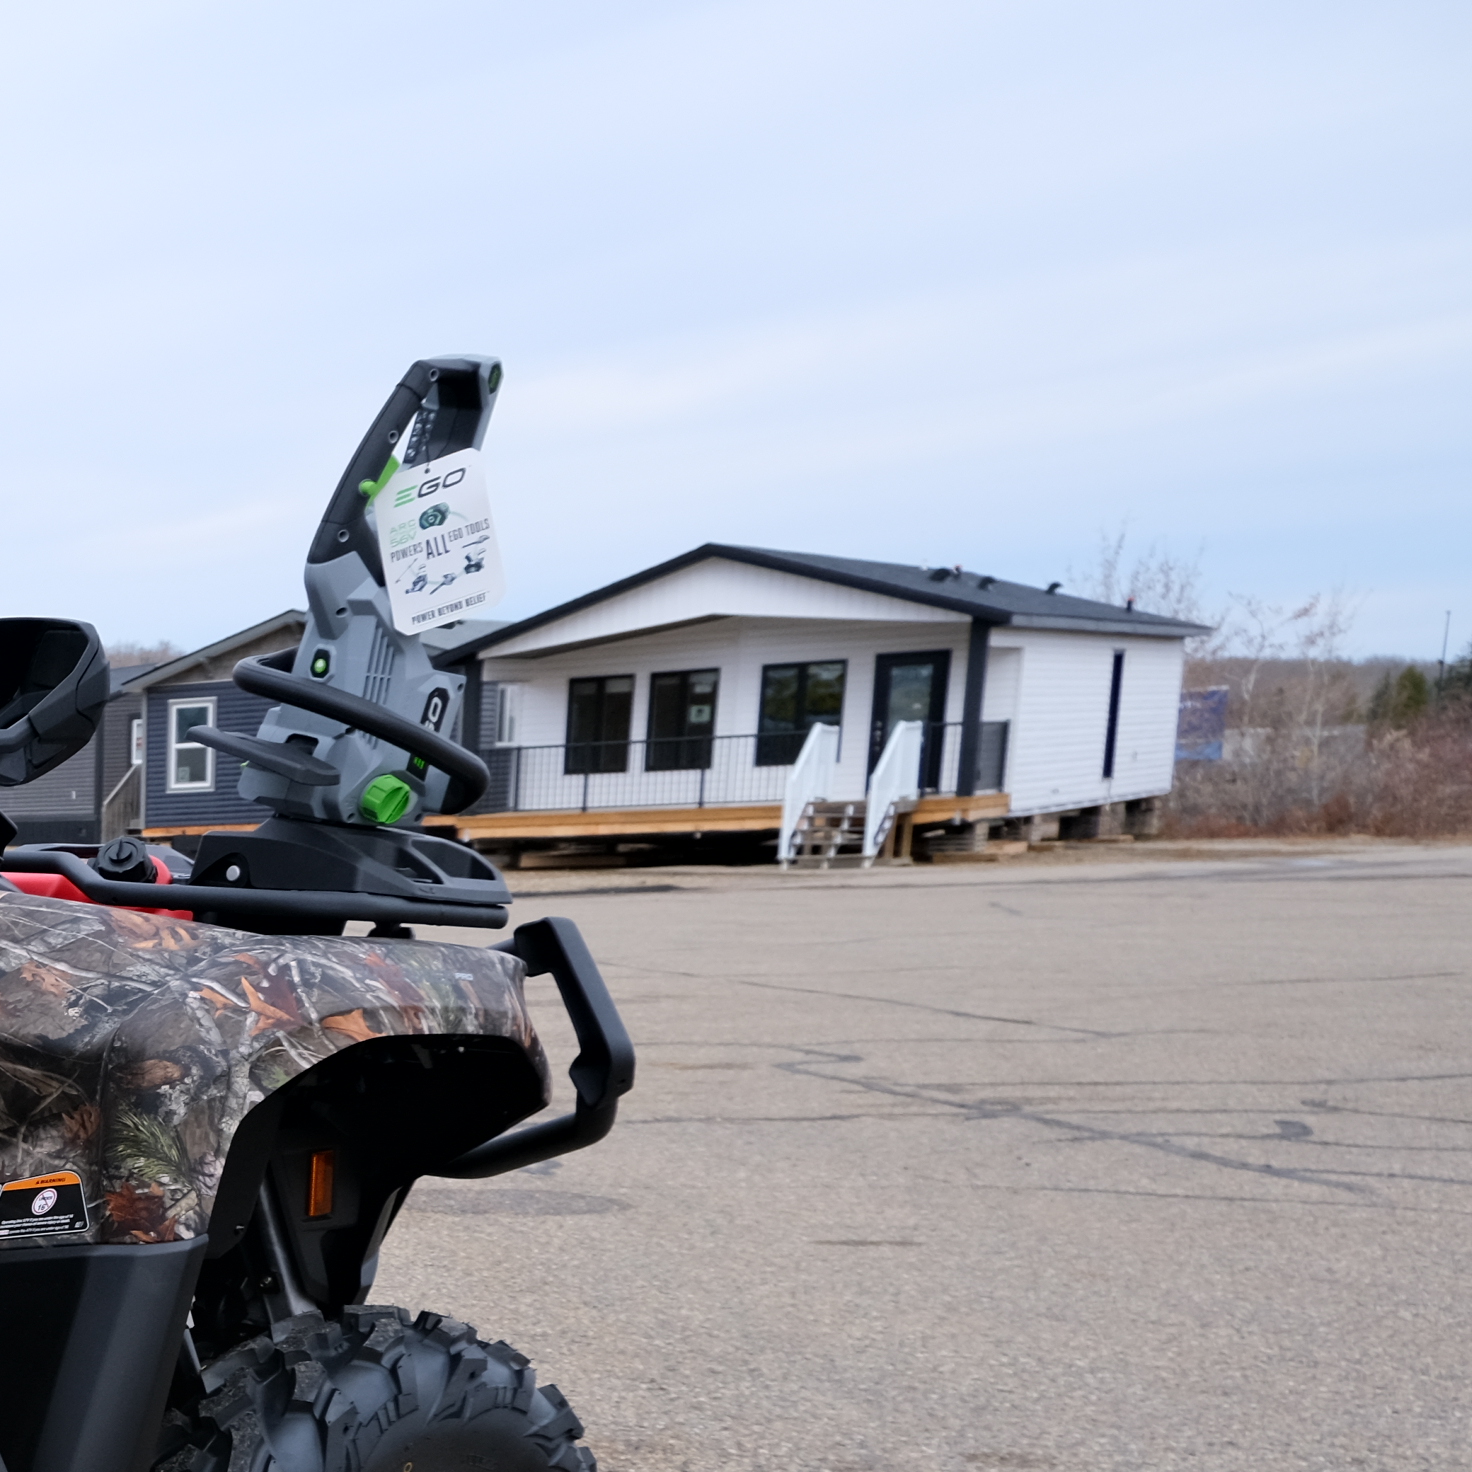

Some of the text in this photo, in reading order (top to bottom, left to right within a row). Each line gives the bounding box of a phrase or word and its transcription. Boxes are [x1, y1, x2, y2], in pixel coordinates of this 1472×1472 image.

[394, 467, 466, 508] EGO
[389, 519, 416, 535] ARC
[390, 532, 417, 548] 56V
[391, 518, 490, 563] POWERS ALL EGO TOOLS
[411, 592, 487, 625] POWER BEYOND BELIEF
